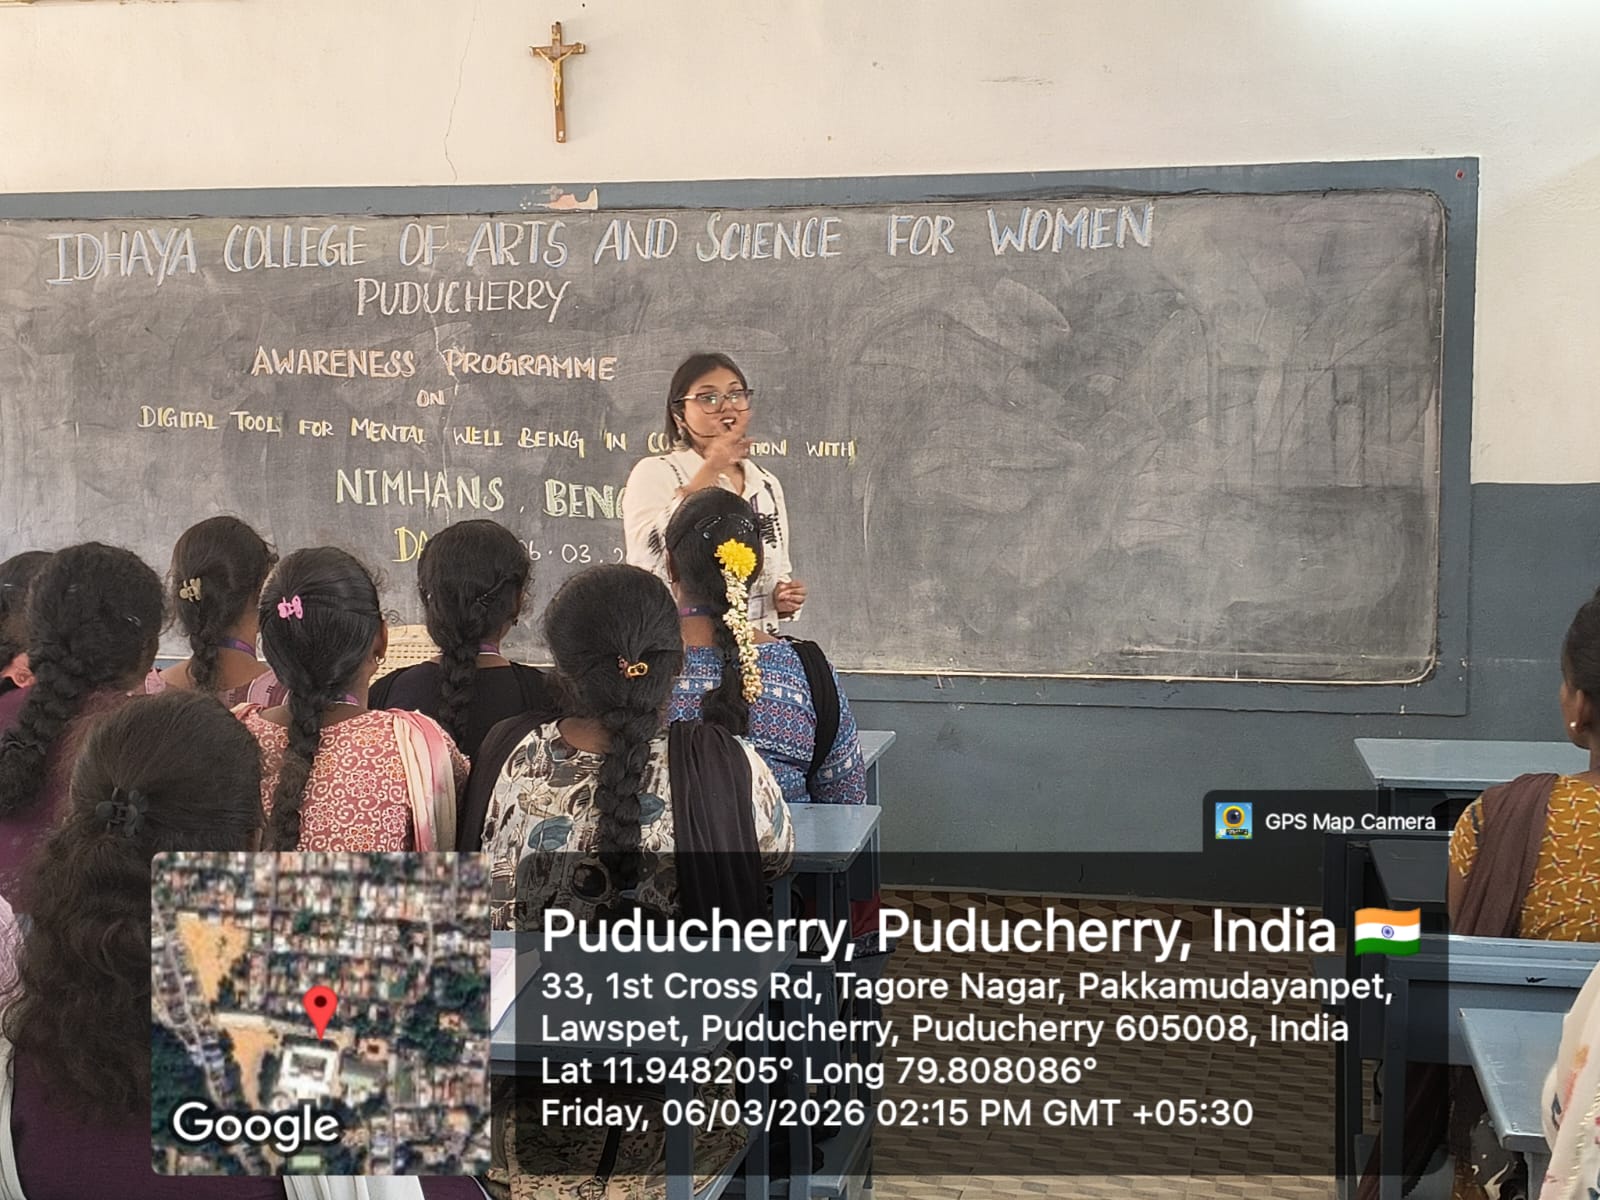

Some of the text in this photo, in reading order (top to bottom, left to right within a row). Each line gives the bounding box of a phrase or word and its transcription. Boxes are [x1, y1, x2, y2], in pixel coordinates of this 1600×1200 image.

[46, 201, 1154, 286] IDHAYA COLLEGE OF ARTS AND SCIENCE FOR WOMEN
[354, 278, 572, 322] PUDUCHERRY
[251, 345, 618, 382] AWARENESS PROGRAMME
[416, 388, 446, 408] ON
[137, 404, 219, 431] DIGITAL
[298, 418, 335, 438] FOR
[350, 417, 426, 444] MENTAL
[453, 427, 504, 448] WELL
[517, 427, 585, 458] BEING
[542, 478, 625, 519] BEN
